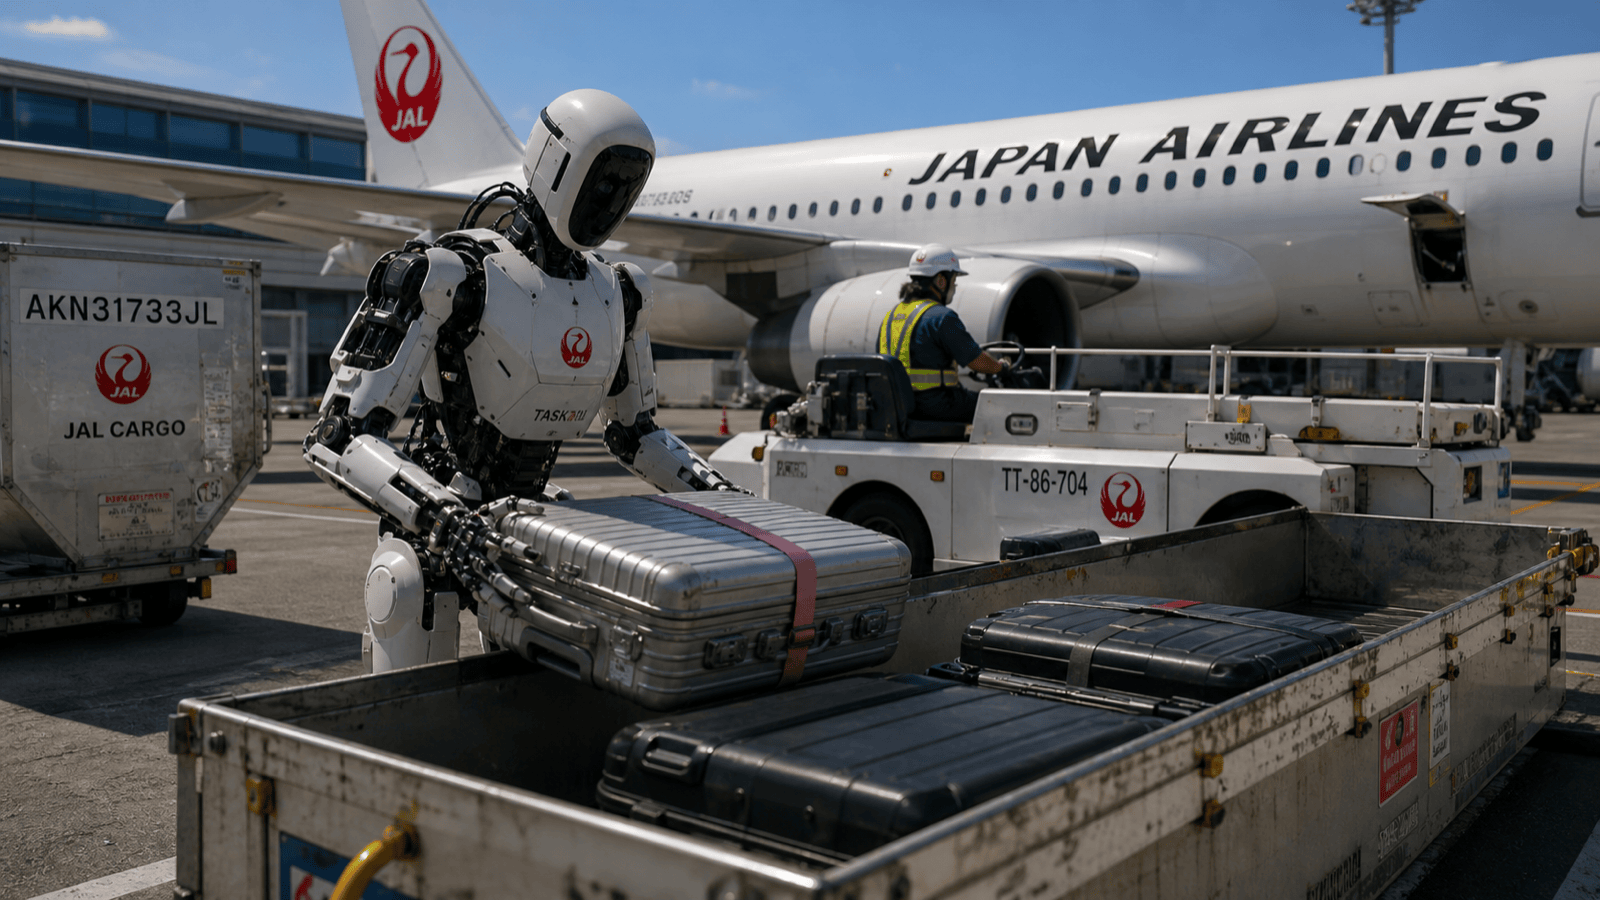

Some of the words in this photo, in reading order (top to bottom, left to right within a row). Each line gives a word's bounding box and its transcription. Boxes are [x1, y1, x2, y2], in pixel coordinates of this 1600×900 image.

[391, 106, 428, 132] JAL
[908, 132, 1120, 185] JAPAN
[1138, 90, 1548, 164] AIRLINES
[26, 293, 218, 325] AKN31733JL
[568, 356, 587, 364] JAL
[109, 386, 140, 398] JAL
[63, 421, 104, 439] JAL
[109, 419, 186, 437] CARGO
[1001, 467, 1088, 496] TT-86-704
[1111, 511, 1138, 524] JAL
